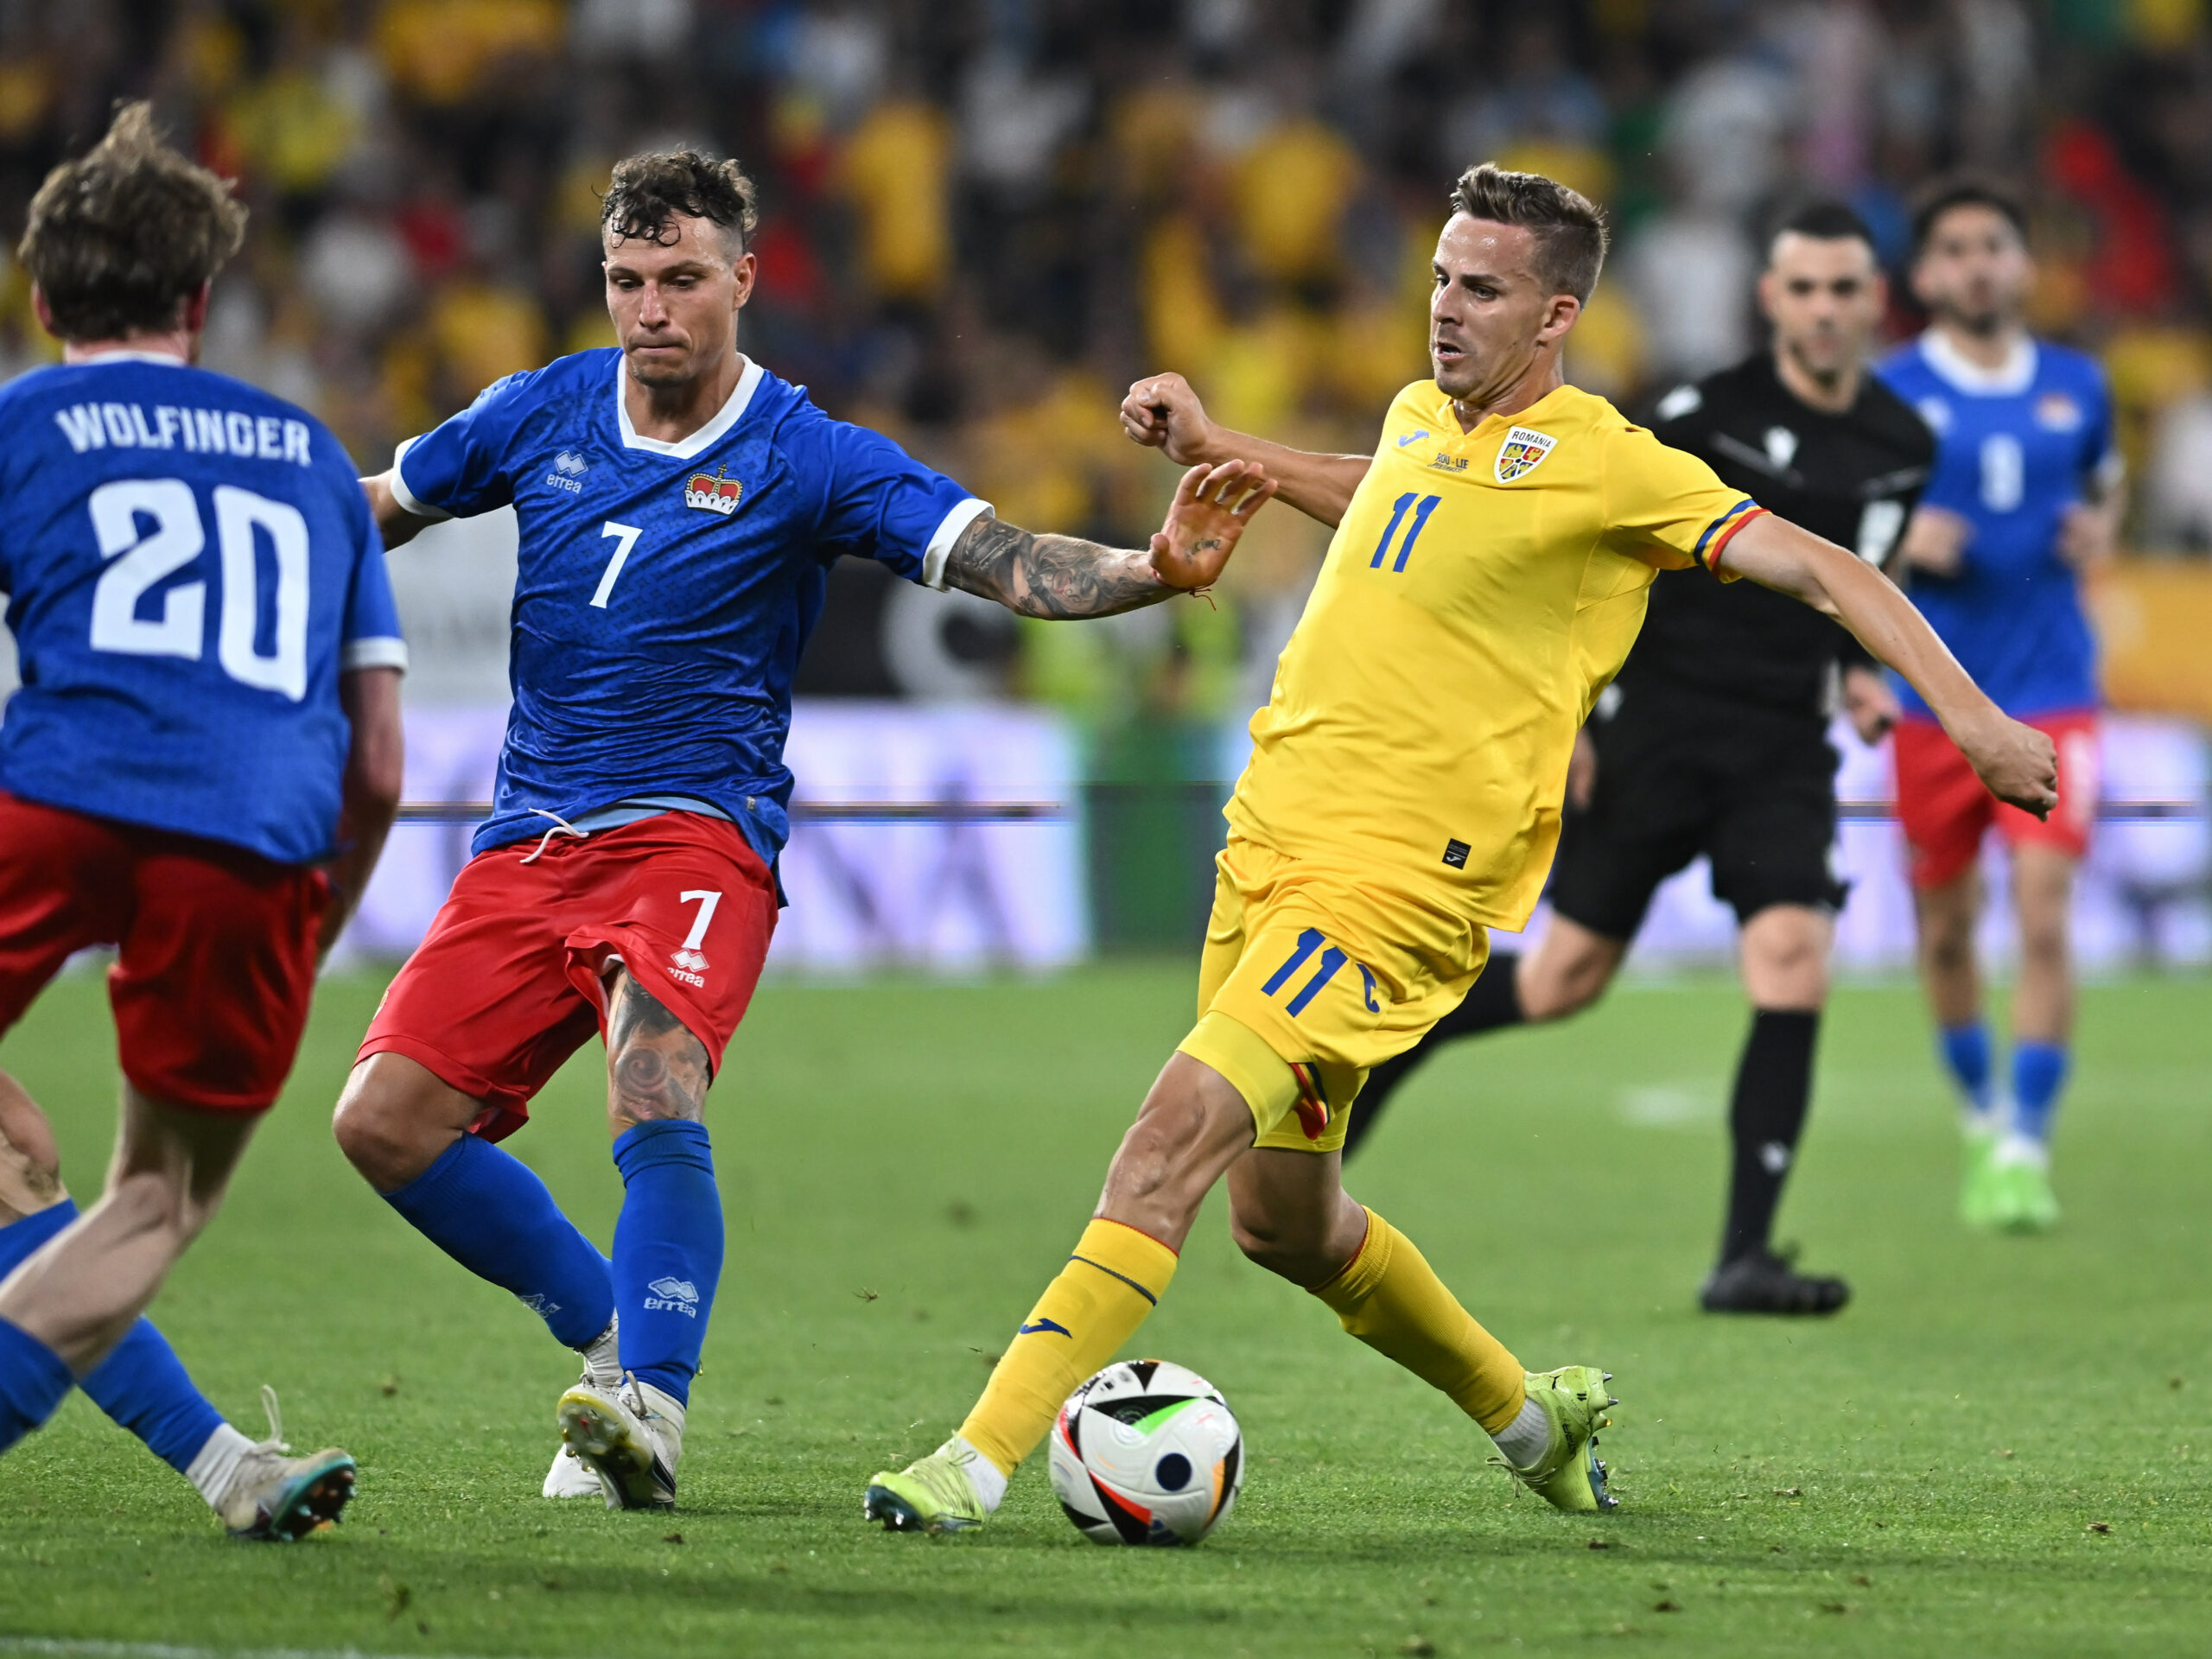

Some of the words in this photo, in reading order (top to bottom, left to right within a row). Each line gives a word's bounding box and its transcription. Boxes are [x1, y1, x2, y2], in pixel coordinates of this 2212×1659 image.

[55, 402, 311, 467] WOLFINGER
[1456, 458, 1469, 469] LIE
[589, 520, 644, 609] 7
[1370, 492, 1442, 573] 11
[88, 477, 310, 702] 20
[680, 889, 723, 950] 7
[1261, 927, 1349, 1019] 11
